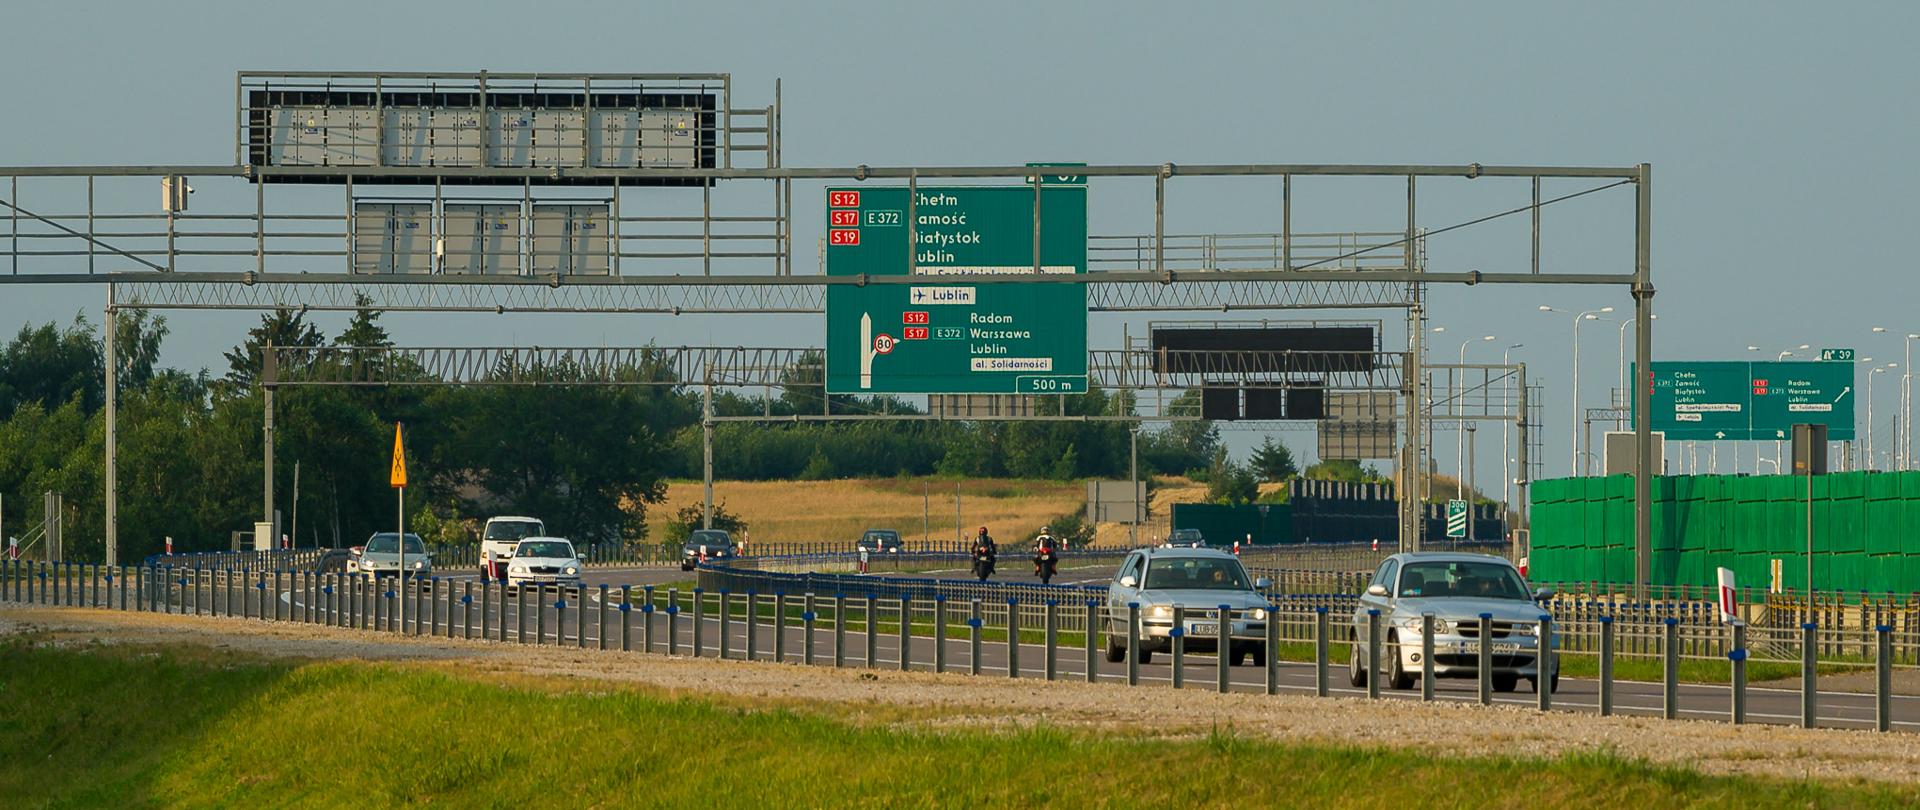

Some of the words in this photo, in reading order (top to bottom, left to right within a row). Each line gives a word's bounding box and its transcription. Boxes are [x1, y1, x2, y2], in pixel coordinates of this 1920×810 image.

[878, 213, 898, 224] 372
[918, 211, 966, 225] amość
[915, 250, 954, 263] ublin
[932, 290, 969, 301] Lublin
[970, 312, 1013, 323] Radom
[970, 328, 1031, 339] Warszawa
[877, 340, 891, 349] 80
[970, 343, 1007, 354] Lublin
[1839, 350, 1851, 360] 39
[1033, 379, 1056, 390] 500
[1061, 382, 1072, 390] m
